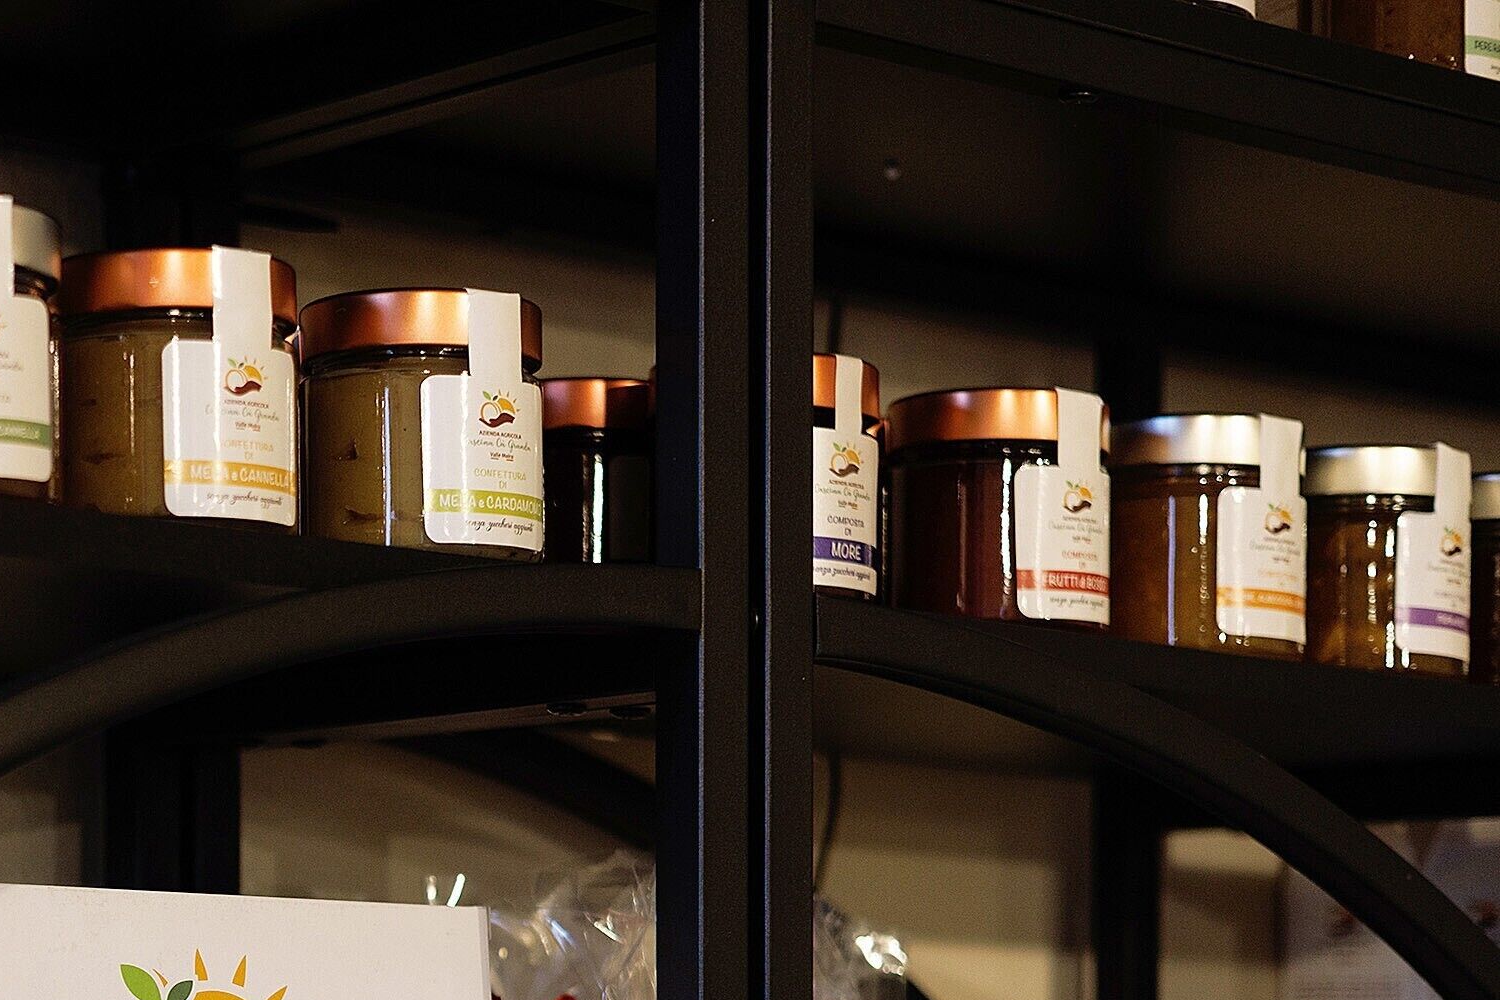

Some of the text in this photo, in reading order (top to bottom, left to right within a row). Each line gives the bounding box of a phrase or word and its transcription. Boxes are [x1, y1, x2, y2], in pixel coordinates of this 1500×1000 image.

[239, 466, 289, 488] CANNELLA
[474, 467, 527, 481] CONFETTURA
[499, 480, 508, 489] DI
[478, 500, 485, 509] e
[827, 515, 865, 528] COMPOSTA
[844, 527, 852, 537] DI
[831, 541, 862, 561] MORE
